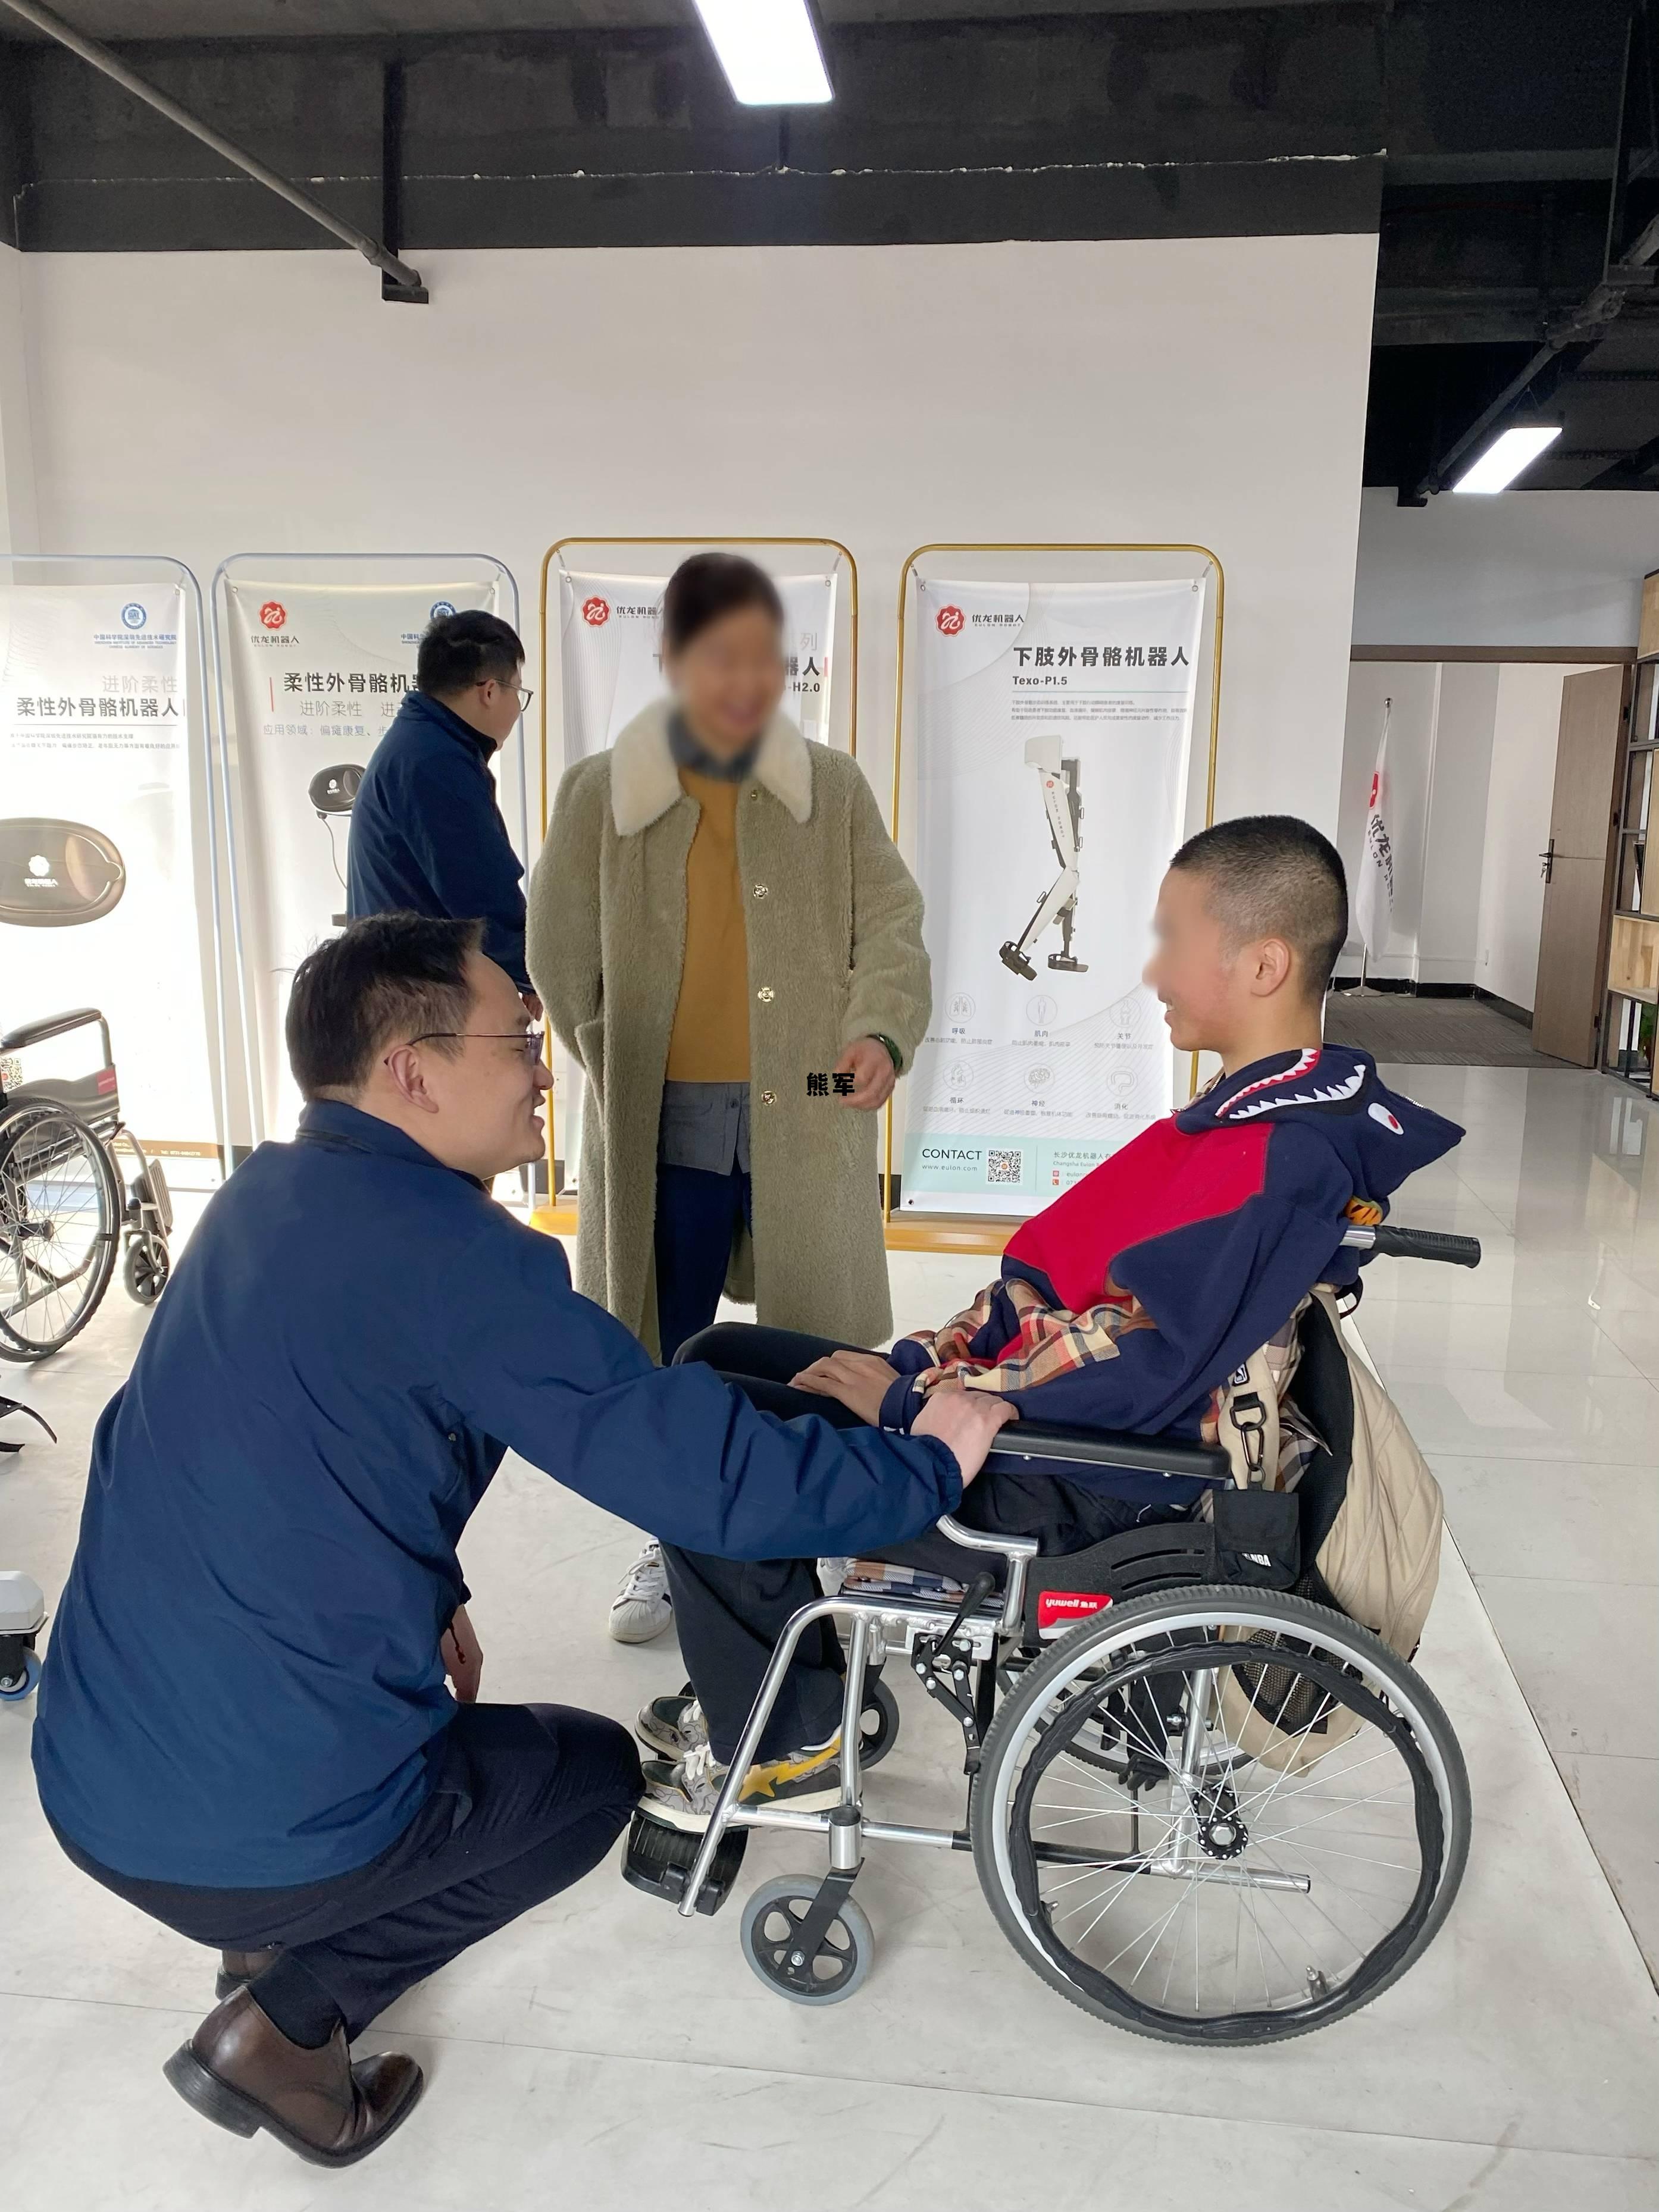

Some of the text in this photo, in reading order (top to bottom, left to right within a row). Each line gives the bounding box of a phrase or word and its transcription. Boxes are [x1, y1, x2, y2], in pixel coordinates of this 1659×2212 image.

[972, 614, 1025, 623] 优龙机器人
[251, 635, 299, 644] 优龙机器人
[1013, 646, 1190, 667] 下肢外骨骼机器人
[102, 675, 178, 693] 进阶柔性
[1013, 676, 1068, 685] Texo-P1.5
[17, 697, 179, 718] 柔性外骨骼机器人
[299, 700, 362, 717] 进阶柔性
[922, 1148, 982, 1161] CONTACT
[1250, 1553, 1272, 1567] NBA
[1045, 1598, 1079, 1608] yuwell
